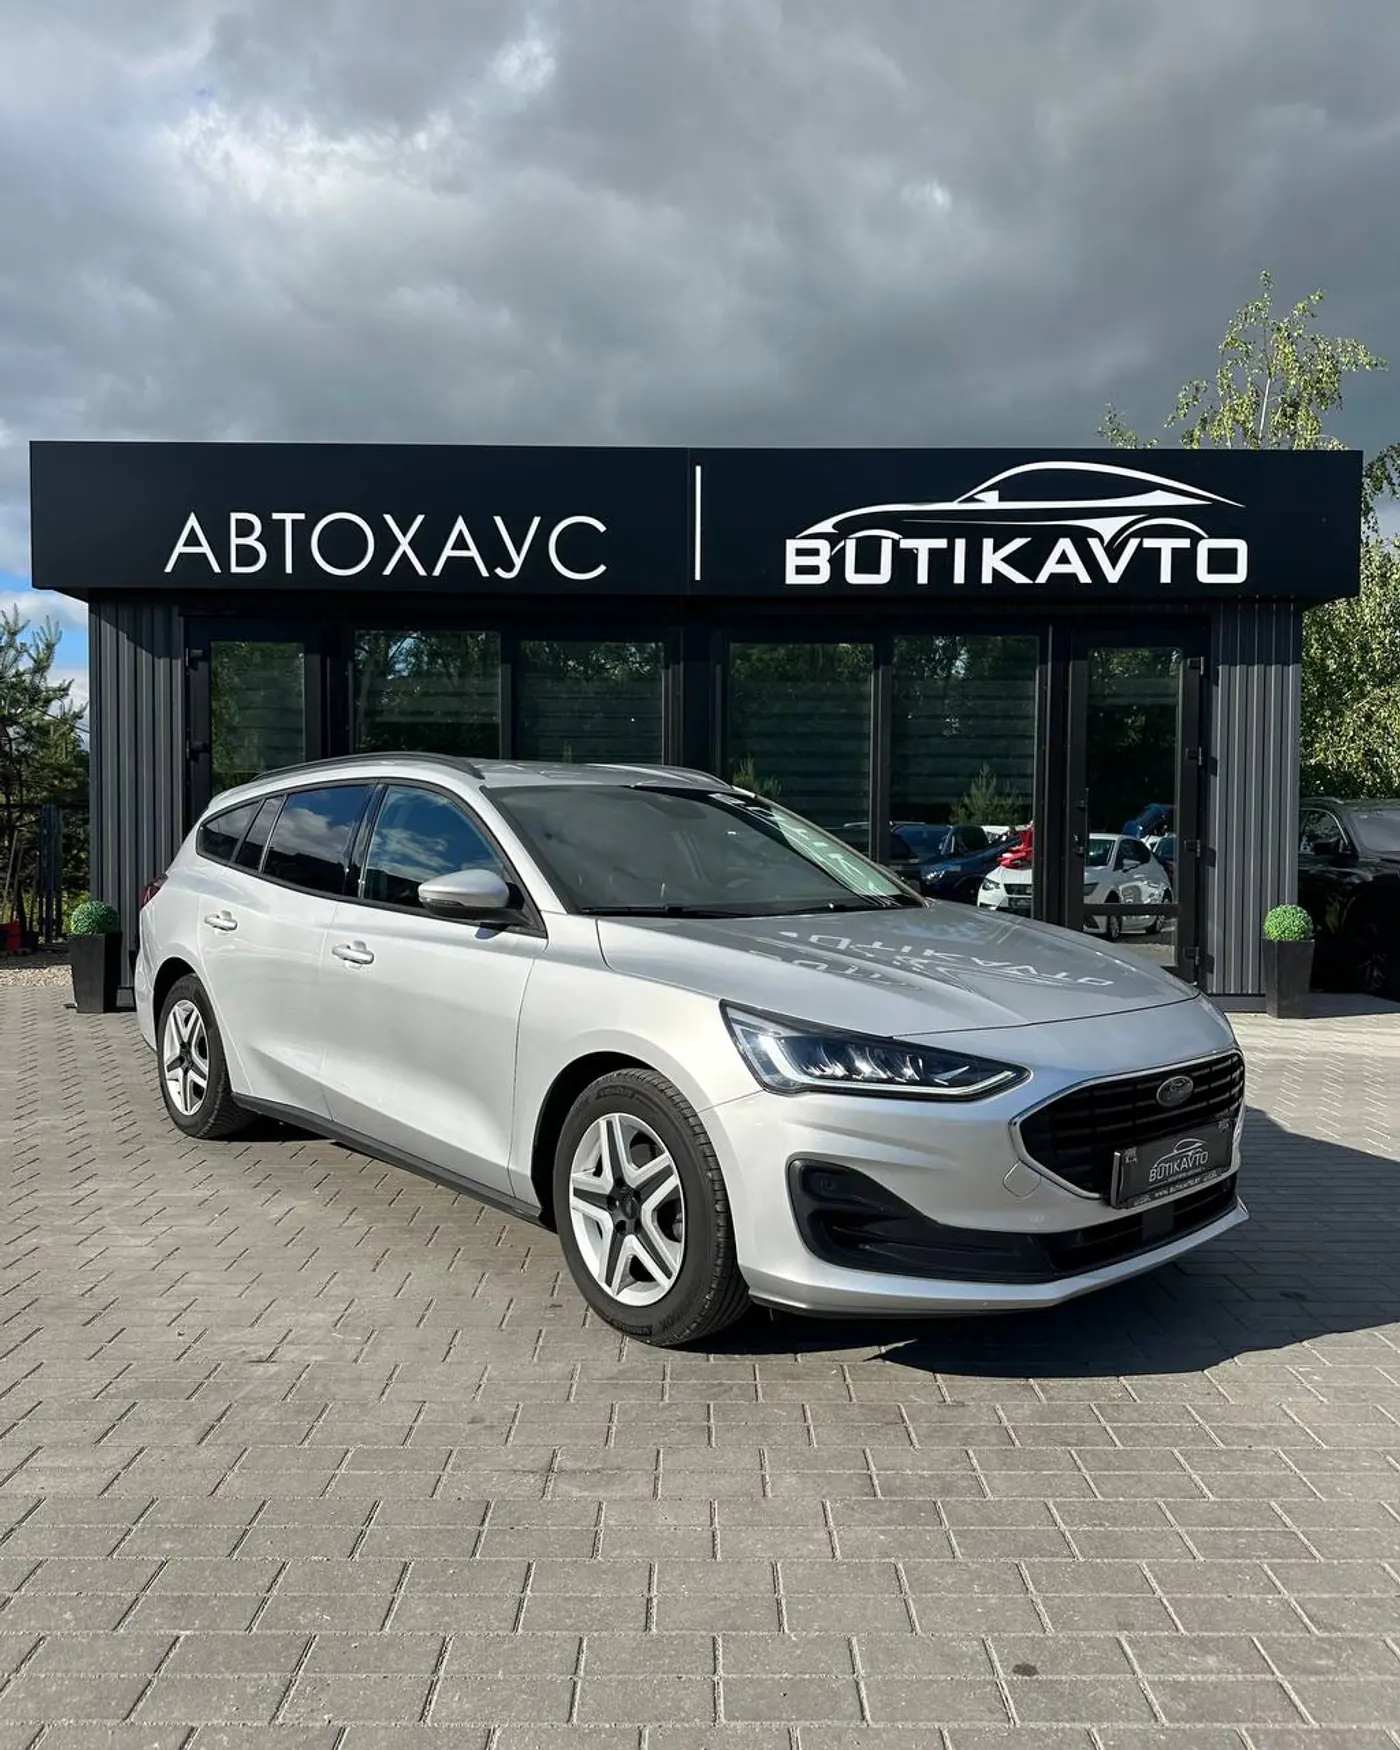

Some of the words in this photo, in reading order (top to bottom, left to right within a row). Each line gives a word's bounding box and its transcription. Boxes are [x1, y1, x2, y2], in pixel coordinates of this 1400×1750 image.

[164, 511, 607, 580] АВТОХАУС
[785, 538, 1248, 585] BUTIKAVTO
[1149, 1151, 1209, 1182] BUTIKAVTO
